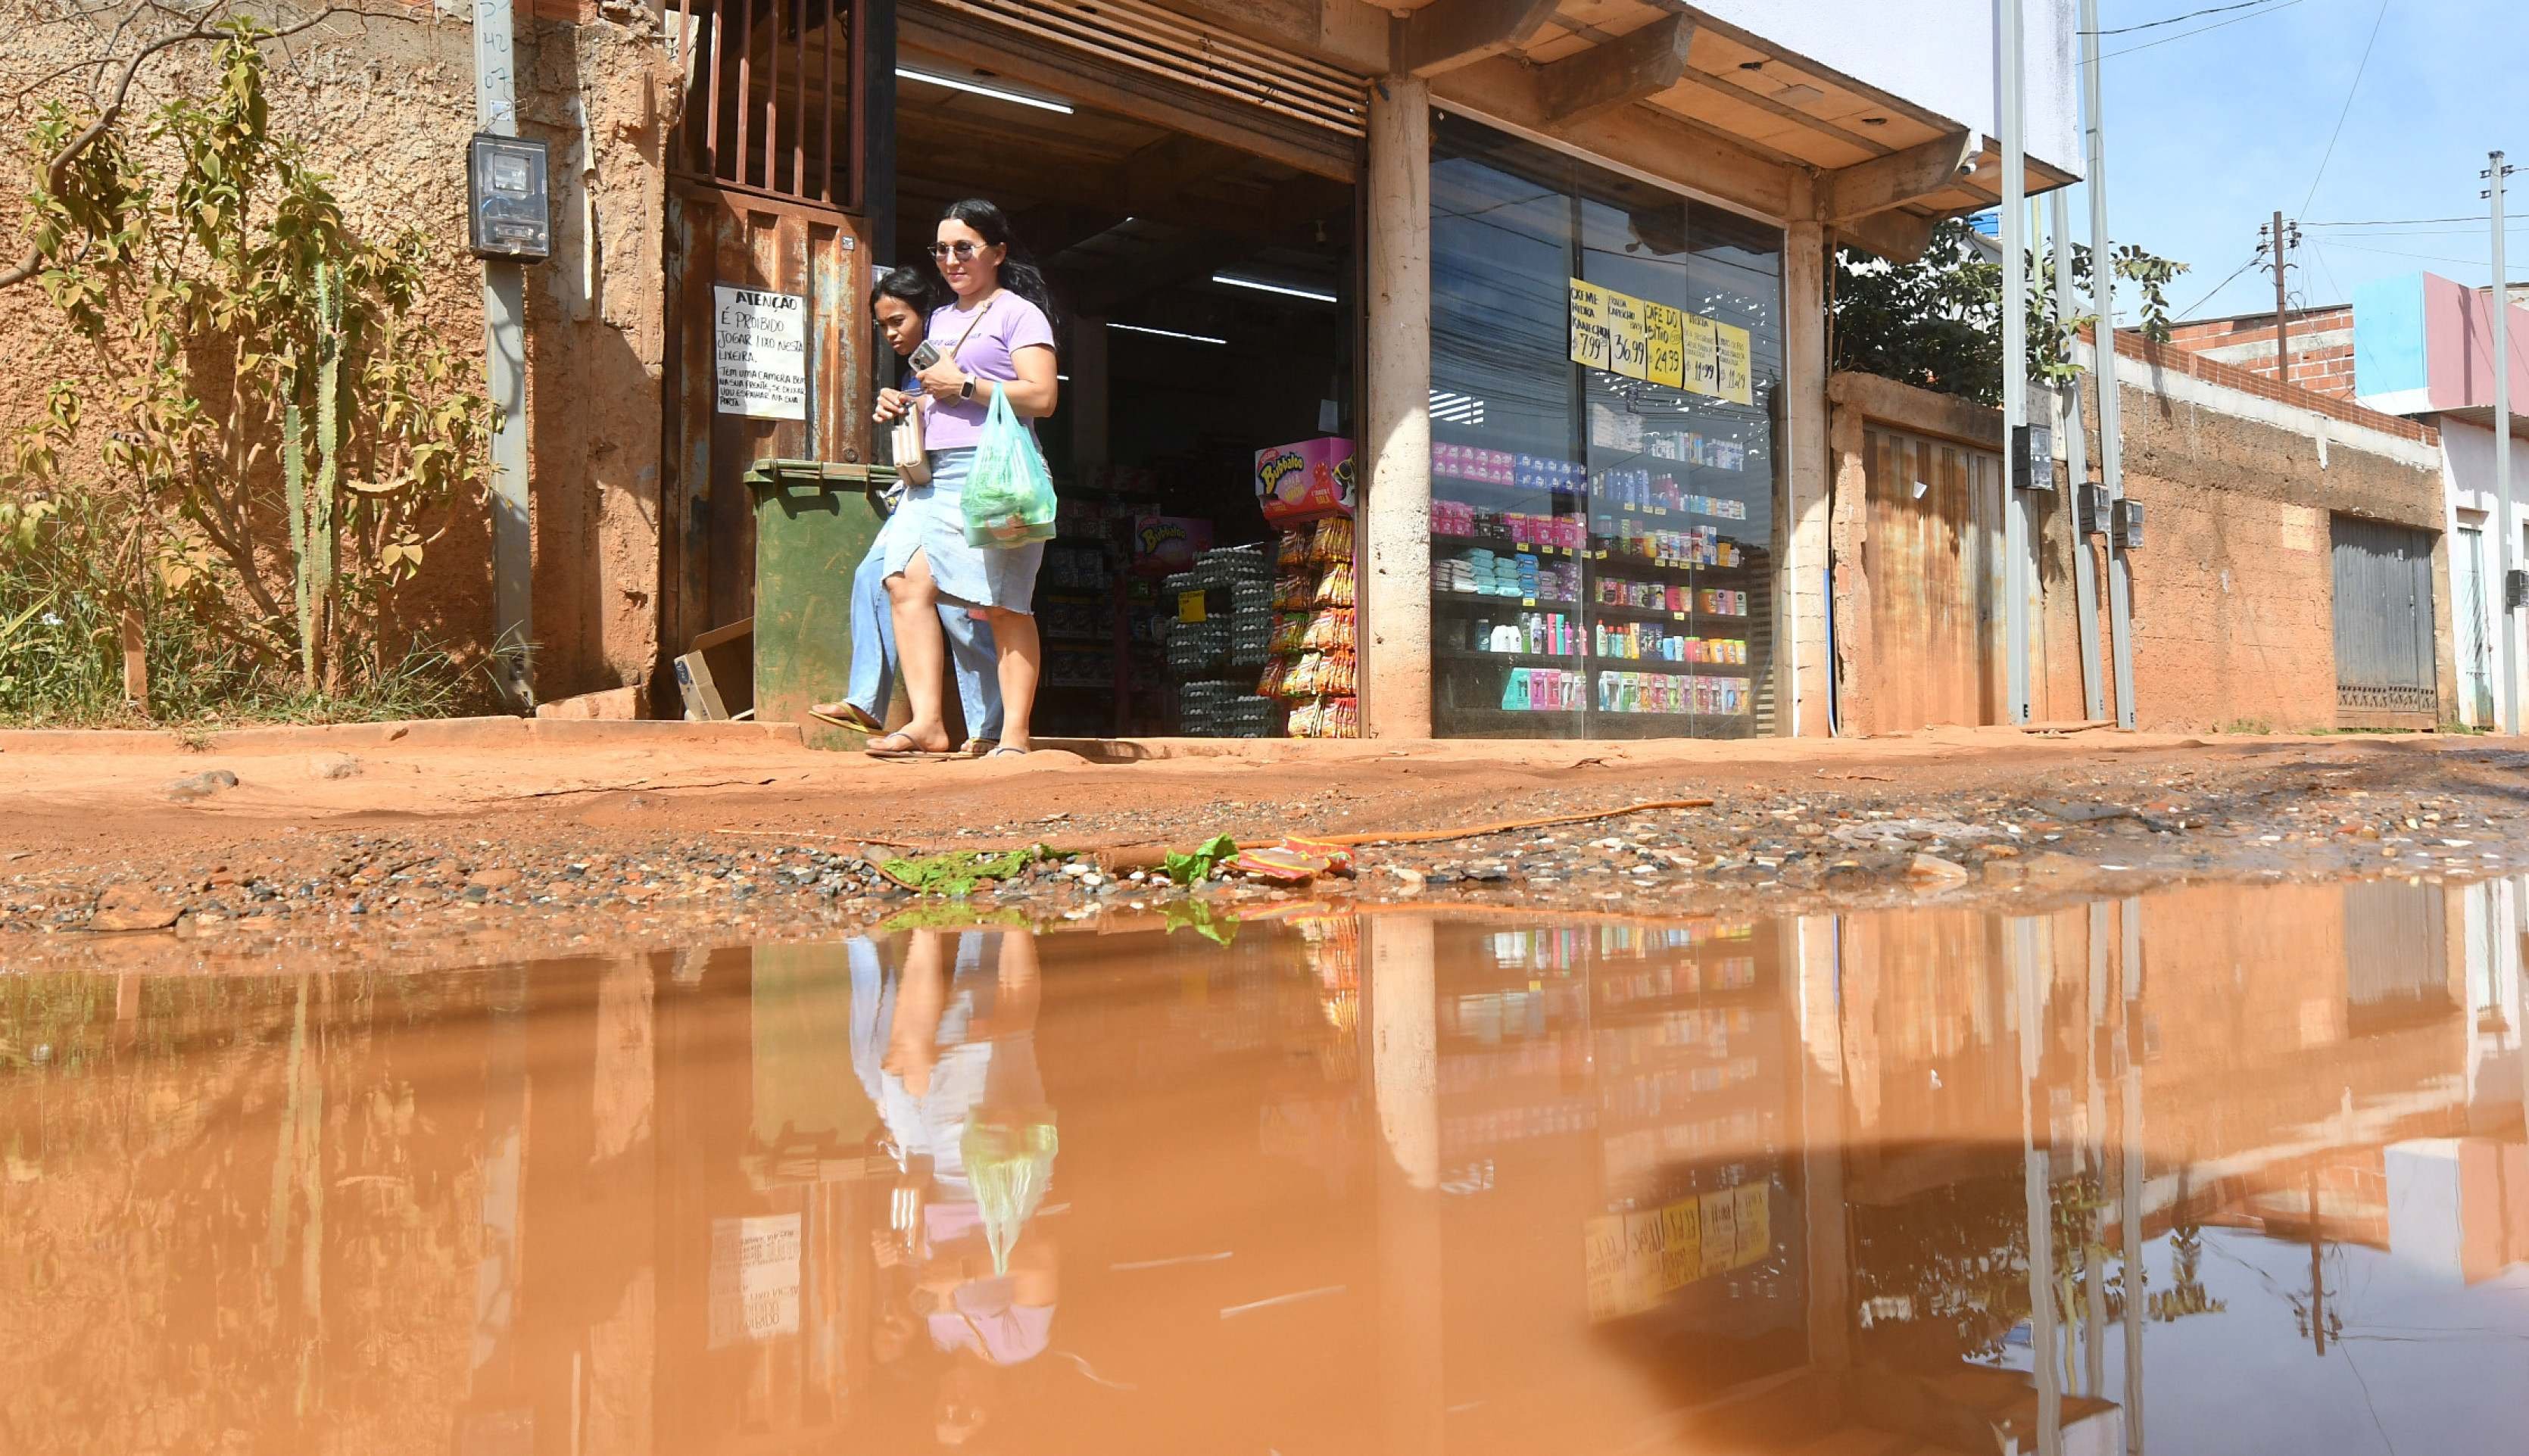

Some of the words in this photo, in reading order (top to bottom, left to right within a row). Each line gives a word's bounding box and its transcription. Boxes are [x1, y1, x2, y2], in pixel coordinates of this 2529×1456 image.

[721, 306, 731, 325] É
[734, 312, 784, 332] PROIBIDO
[716, 330, 753, 348] JOGAR
[756, 335, 775, 349] LIXO
[777, 340, 803, 352] NESTA
[719, 366, 737, 378] TEM
[739, 369, 756, 379] UMA
[720, 387, 735, 397] VOU
[1259, 451, 1305, 494] Bubbaloo
